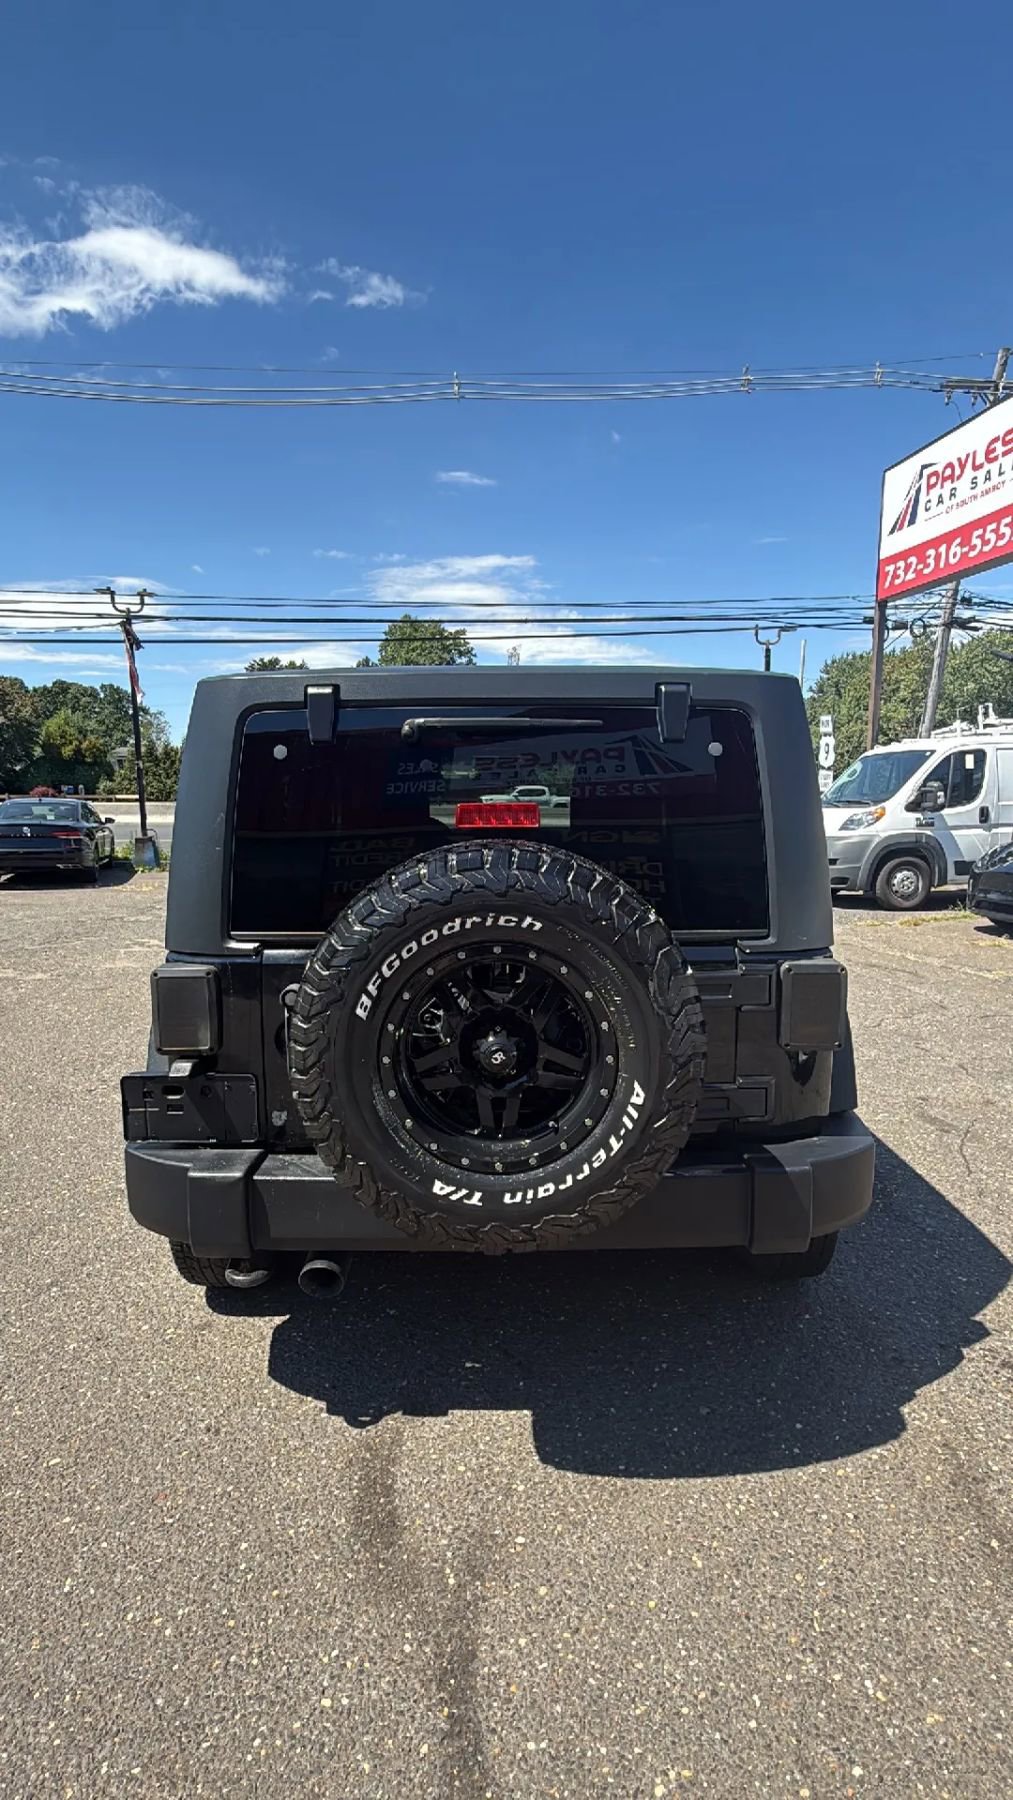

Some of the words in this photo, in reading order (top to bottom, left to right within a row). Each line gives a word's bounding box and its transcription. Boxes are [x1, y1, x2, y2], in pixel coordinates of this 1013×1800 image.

[924, 486, 957, 512] CAR
[970, 459, 1013, 491] SAL
[945, 504, 955, 514] OF
[955, 492, 979, 510] SOUTH
[979, 479, 1007, 499] AMBOY
[883, 515, 1013, 589] 732-316-555
[823, 742, 830, 761] 9
[355, 912, 544, 1021] BFGoodrich
[503, 1080, 647, 1206] All-Terrain
[431, 1178, 484, 1207] T/A
